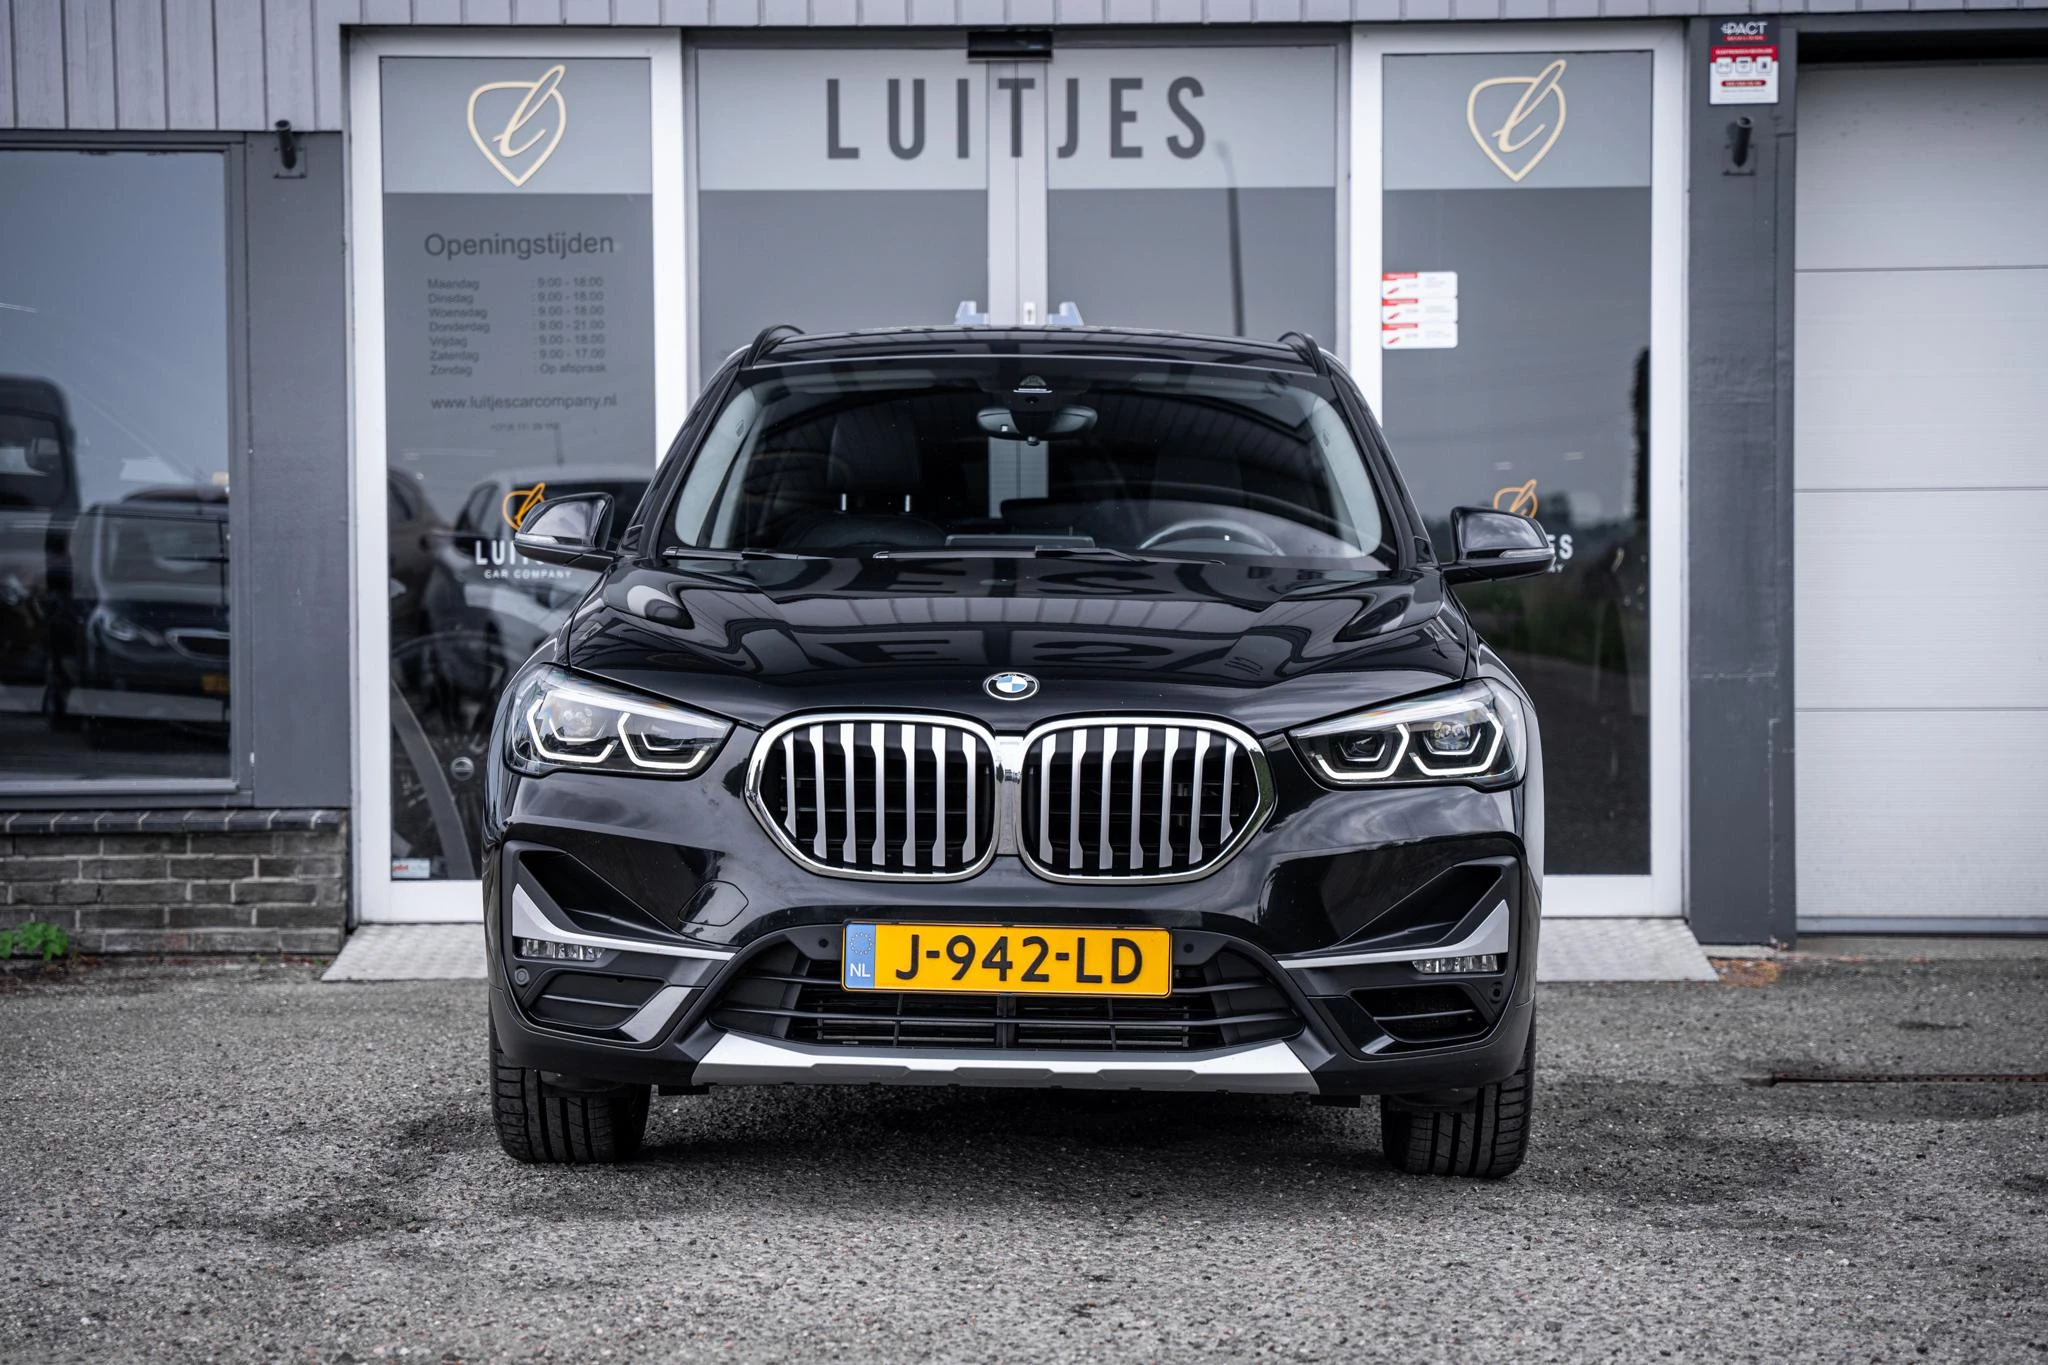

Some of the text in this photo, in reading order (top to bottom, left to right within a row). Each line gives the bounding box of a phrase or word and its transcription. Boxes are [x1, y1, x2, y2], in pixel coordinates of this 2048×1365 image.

[826, 75, 1205, 160] LUITJES
[424, 232, 614, 261] Openingstijden
[431, 393, 617, 411] www.luitjescarcompany.nl
[484, 569, 572, 580] CAR COMPANY
[849, 933, 1142, 984] NL J-942-LD
